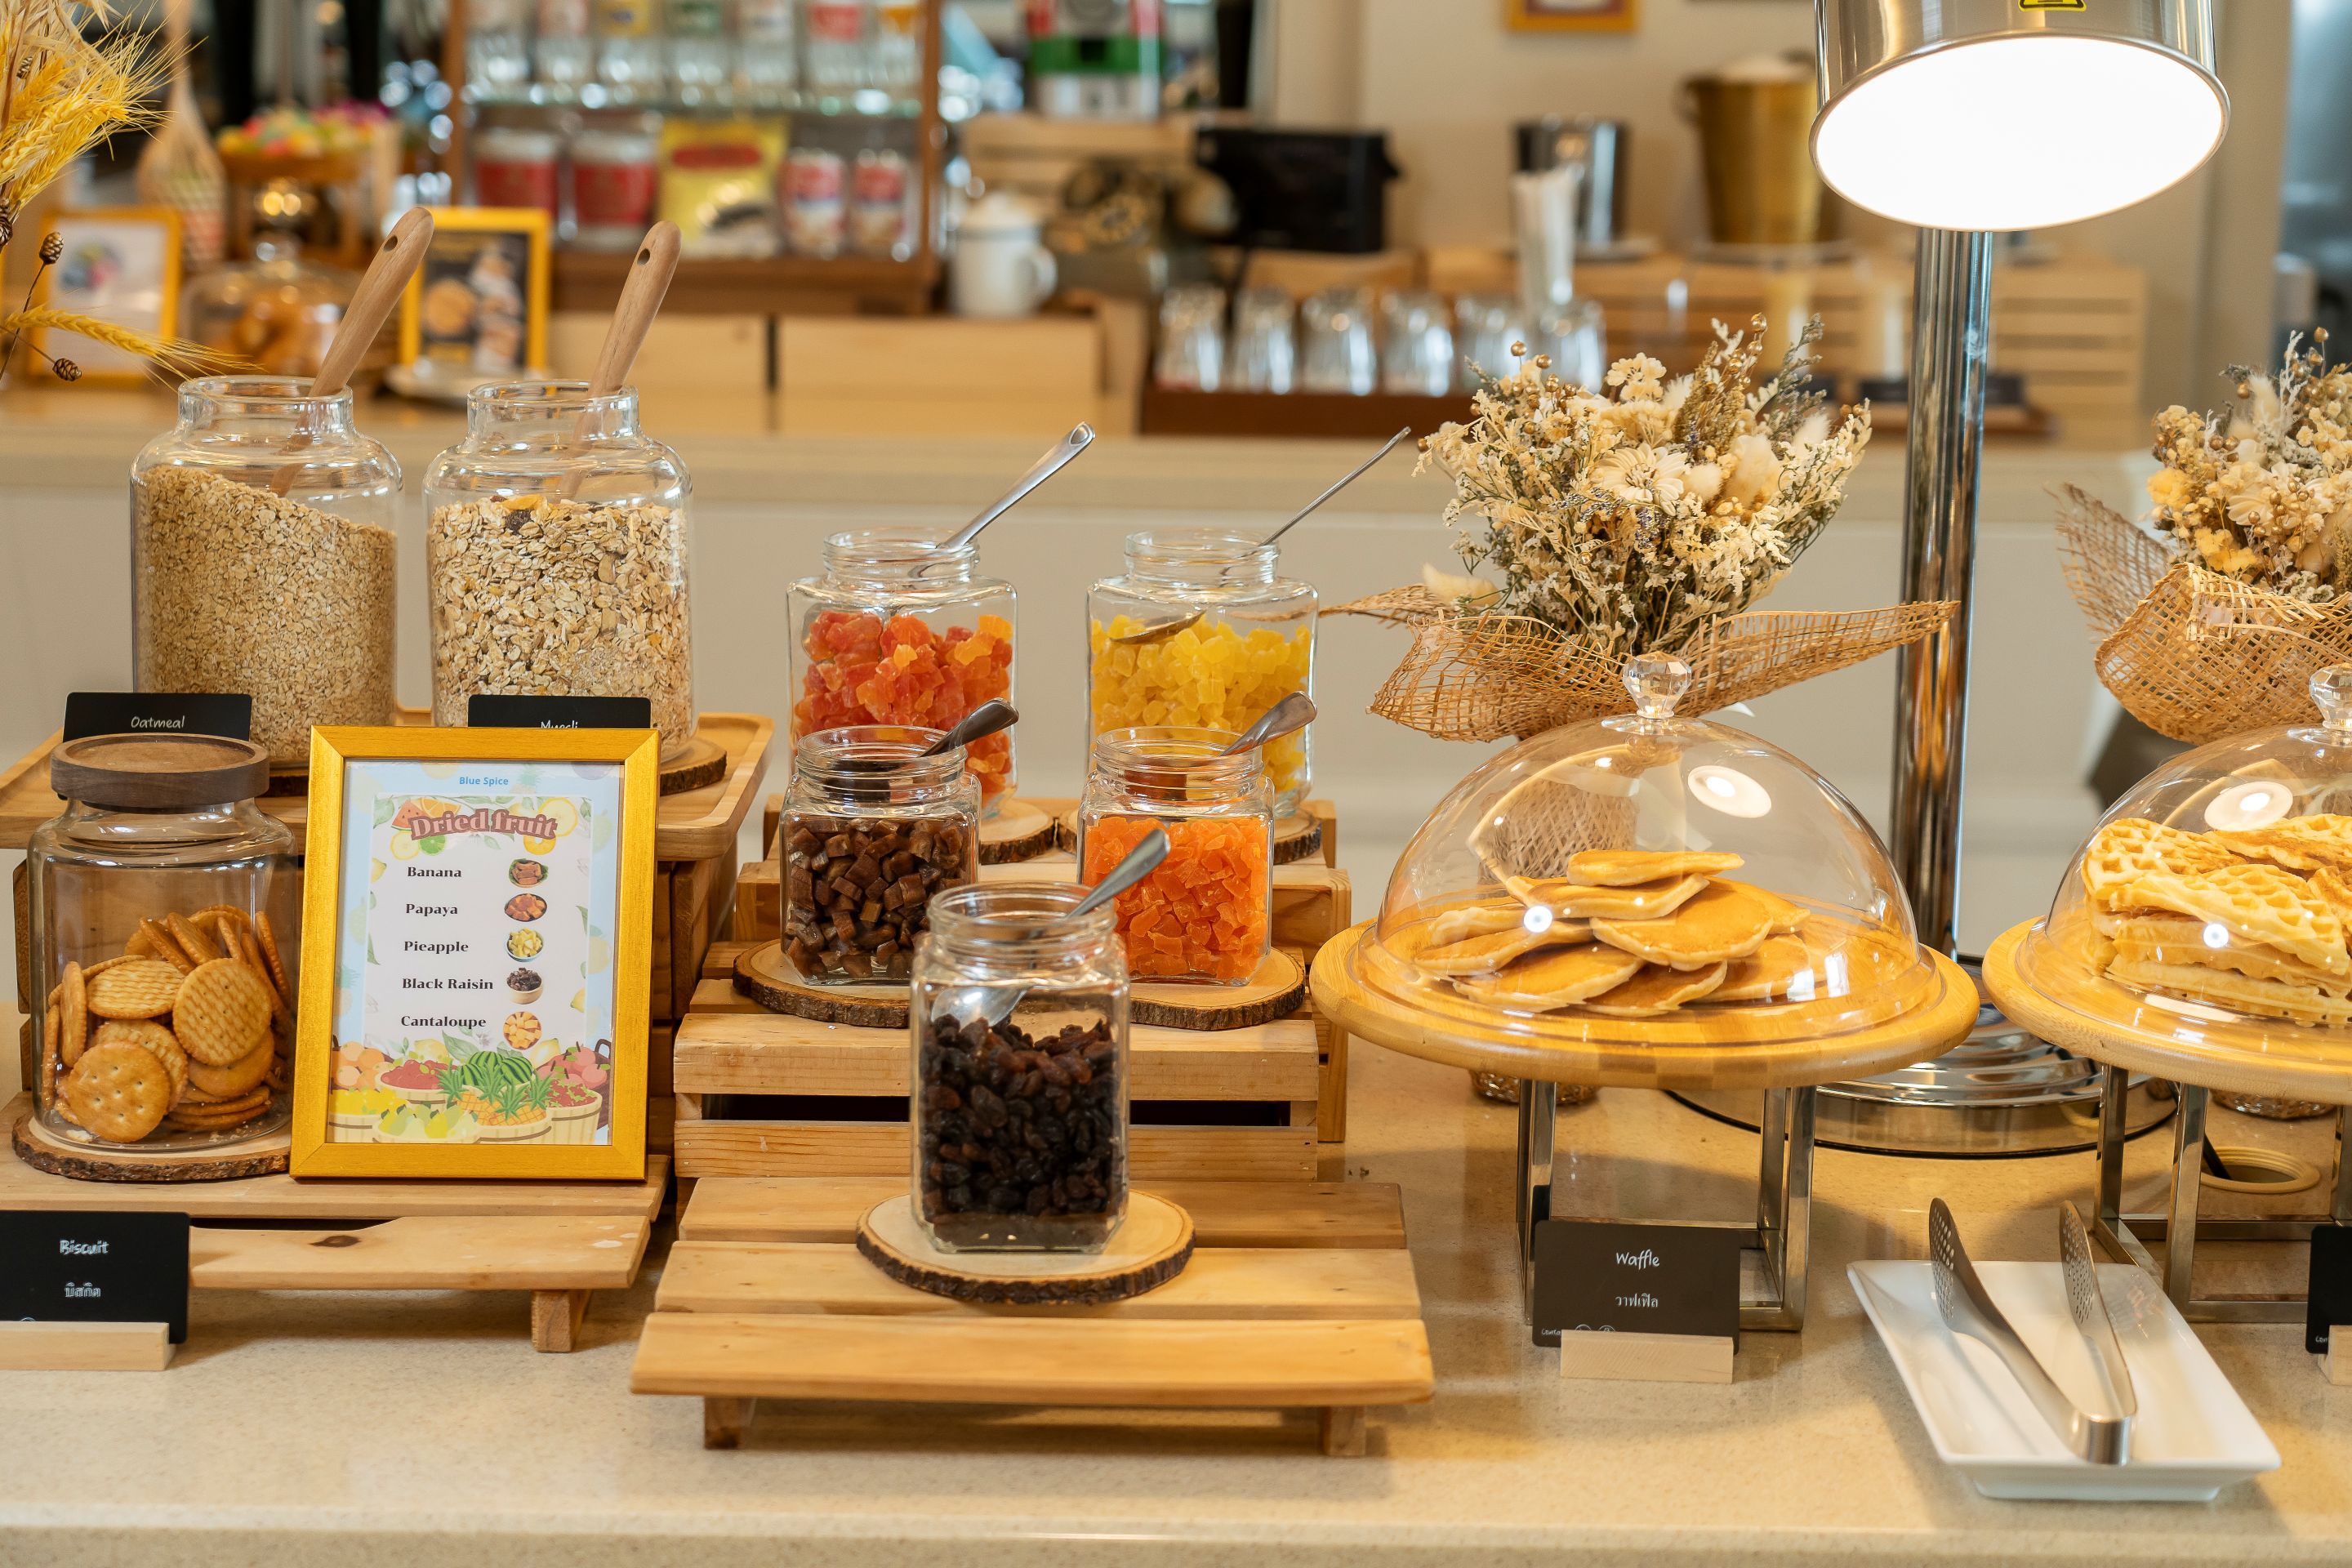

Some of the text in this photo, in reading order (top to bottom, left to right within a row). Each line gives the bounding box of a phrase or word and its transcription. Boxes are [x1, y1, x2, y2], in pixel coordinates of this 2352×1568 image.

[131, 715, 185, 729] Oatmeal
[459, 777, 509, 787] Blue Spice
[411, 808, 558, 840] Dried fruit
[408, 866, 462, 878] Banana
[406, 903, 458, 916] Papaya
[404, 941, 469, 954] Pieapple
[403, 978, 493, 990] Black Raisin
[401, 1016, 487, 1029] Cantaloupe
[59, 1239, 109, 1255] Biscuit
[1615, 1249, 1660, 1270] Waffle
